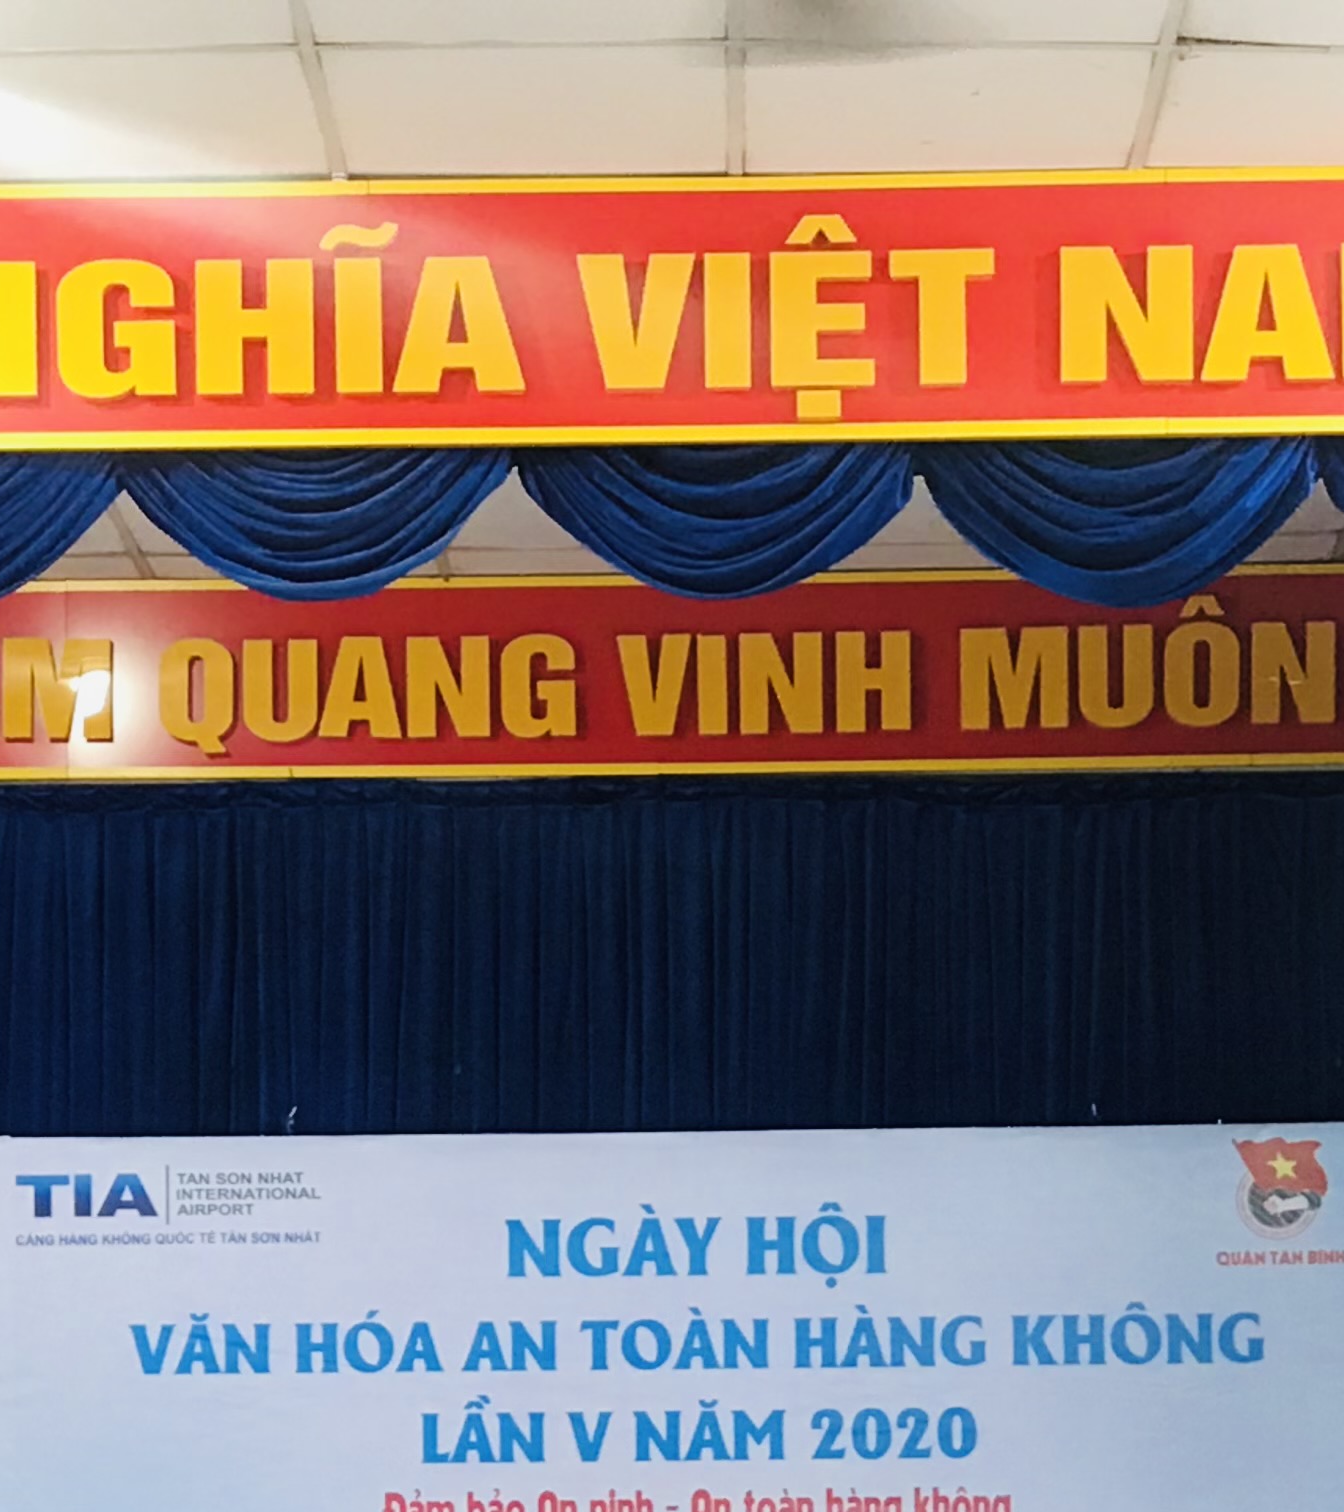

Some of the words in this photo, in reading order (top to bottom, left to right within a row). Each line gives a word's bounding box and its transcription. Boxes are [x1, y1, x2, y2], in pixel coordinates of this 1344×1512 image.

[576, 213, 995, 420] VIỆT
[158, 633, 585, 754] QUANG
[618, 629, 912, 740] VINH
[960, 596, 1336, 732] MUÔN
[15, 1173, 158, 1218] TIA
[176, 1188, 321, 1200] INTERNATIONAL
[177, 1173, 210, 1184] TAN
[216, 1173, 252, 1184] SON
[257, 1172, 304, 1184] NHAT
[177, 1203, 254, 1216] AIRPORT
[505, 1203, 722, 1278] NGÀY
[745, 1201, 887, 1289] HỘI
[128, 1312, 271, 1376] VĂN
[294, 1309, 445, 1374] HÓA
[461, 1320, 558, 1372] AN
[579, 1306, 770, 1371] TOÀN
[793, 1304, 987, 1369] HÀNG
[1012, 1301, 1265, 1366] KHÔNG
[421, 1394, 546, 1464] LẦN
[566, 1411, 614, 1463] V
[632, 1399, 786, 1462] NĂM
[810, 1406, 979, 1460] 2020
